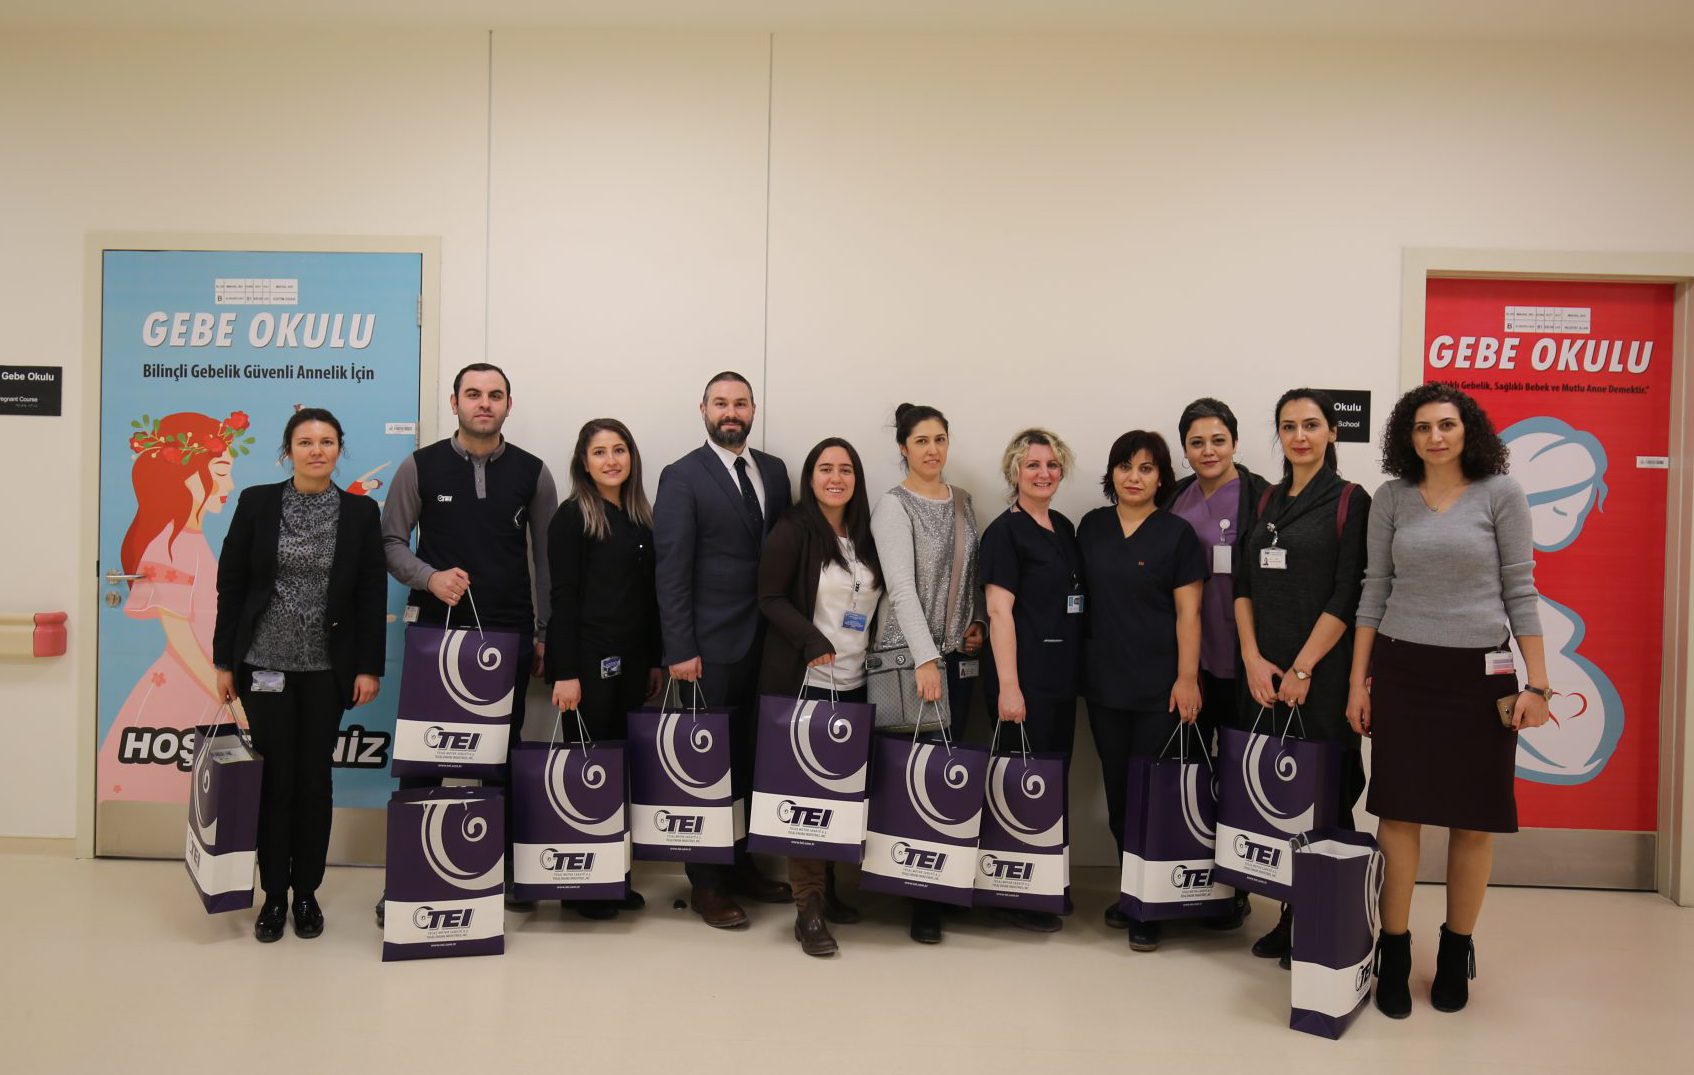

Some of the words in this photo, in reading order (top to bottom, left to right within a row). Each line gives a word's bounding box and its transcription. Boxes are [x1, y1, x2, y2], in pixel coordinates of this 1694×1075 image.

[142, 311, 237, 347] GEBE
[248, 312, 376, 349] OKULU
[1429, 335, 1520, 369] GEBE
[1531, 338, 1653, 373] OKULU
[1, 371, 26, 381] Gebe
[27, 372, 55, 382] Okulu
[143, 363, 188, 381] Bilinçli
[191, 364, 240, 379] Gebelik
[244, 364, 293, 380] Güvenli
[297, 365, 347, 380] Annelik
[351, 362, 374, 383] İçin
[1525, 383, 1550, 392] Bebek
[1561, 384, 1585, 393] Mutlu
[1333, 402, 1362, 412] Okulu
[1337, 420, 1361, 428] School
[437, 731, 482, 752] TEI
[665, 814, 706, 835] TEI
[789, 805, 835, 829] TEI
[552, 852, 596, 872] TEI
[904, 847, 949, 873] TEI
[1244, 840, 1283, 870] TEI
[992, 859, 1035, 882] TEI
[427, 908, 475, 930] TEI
